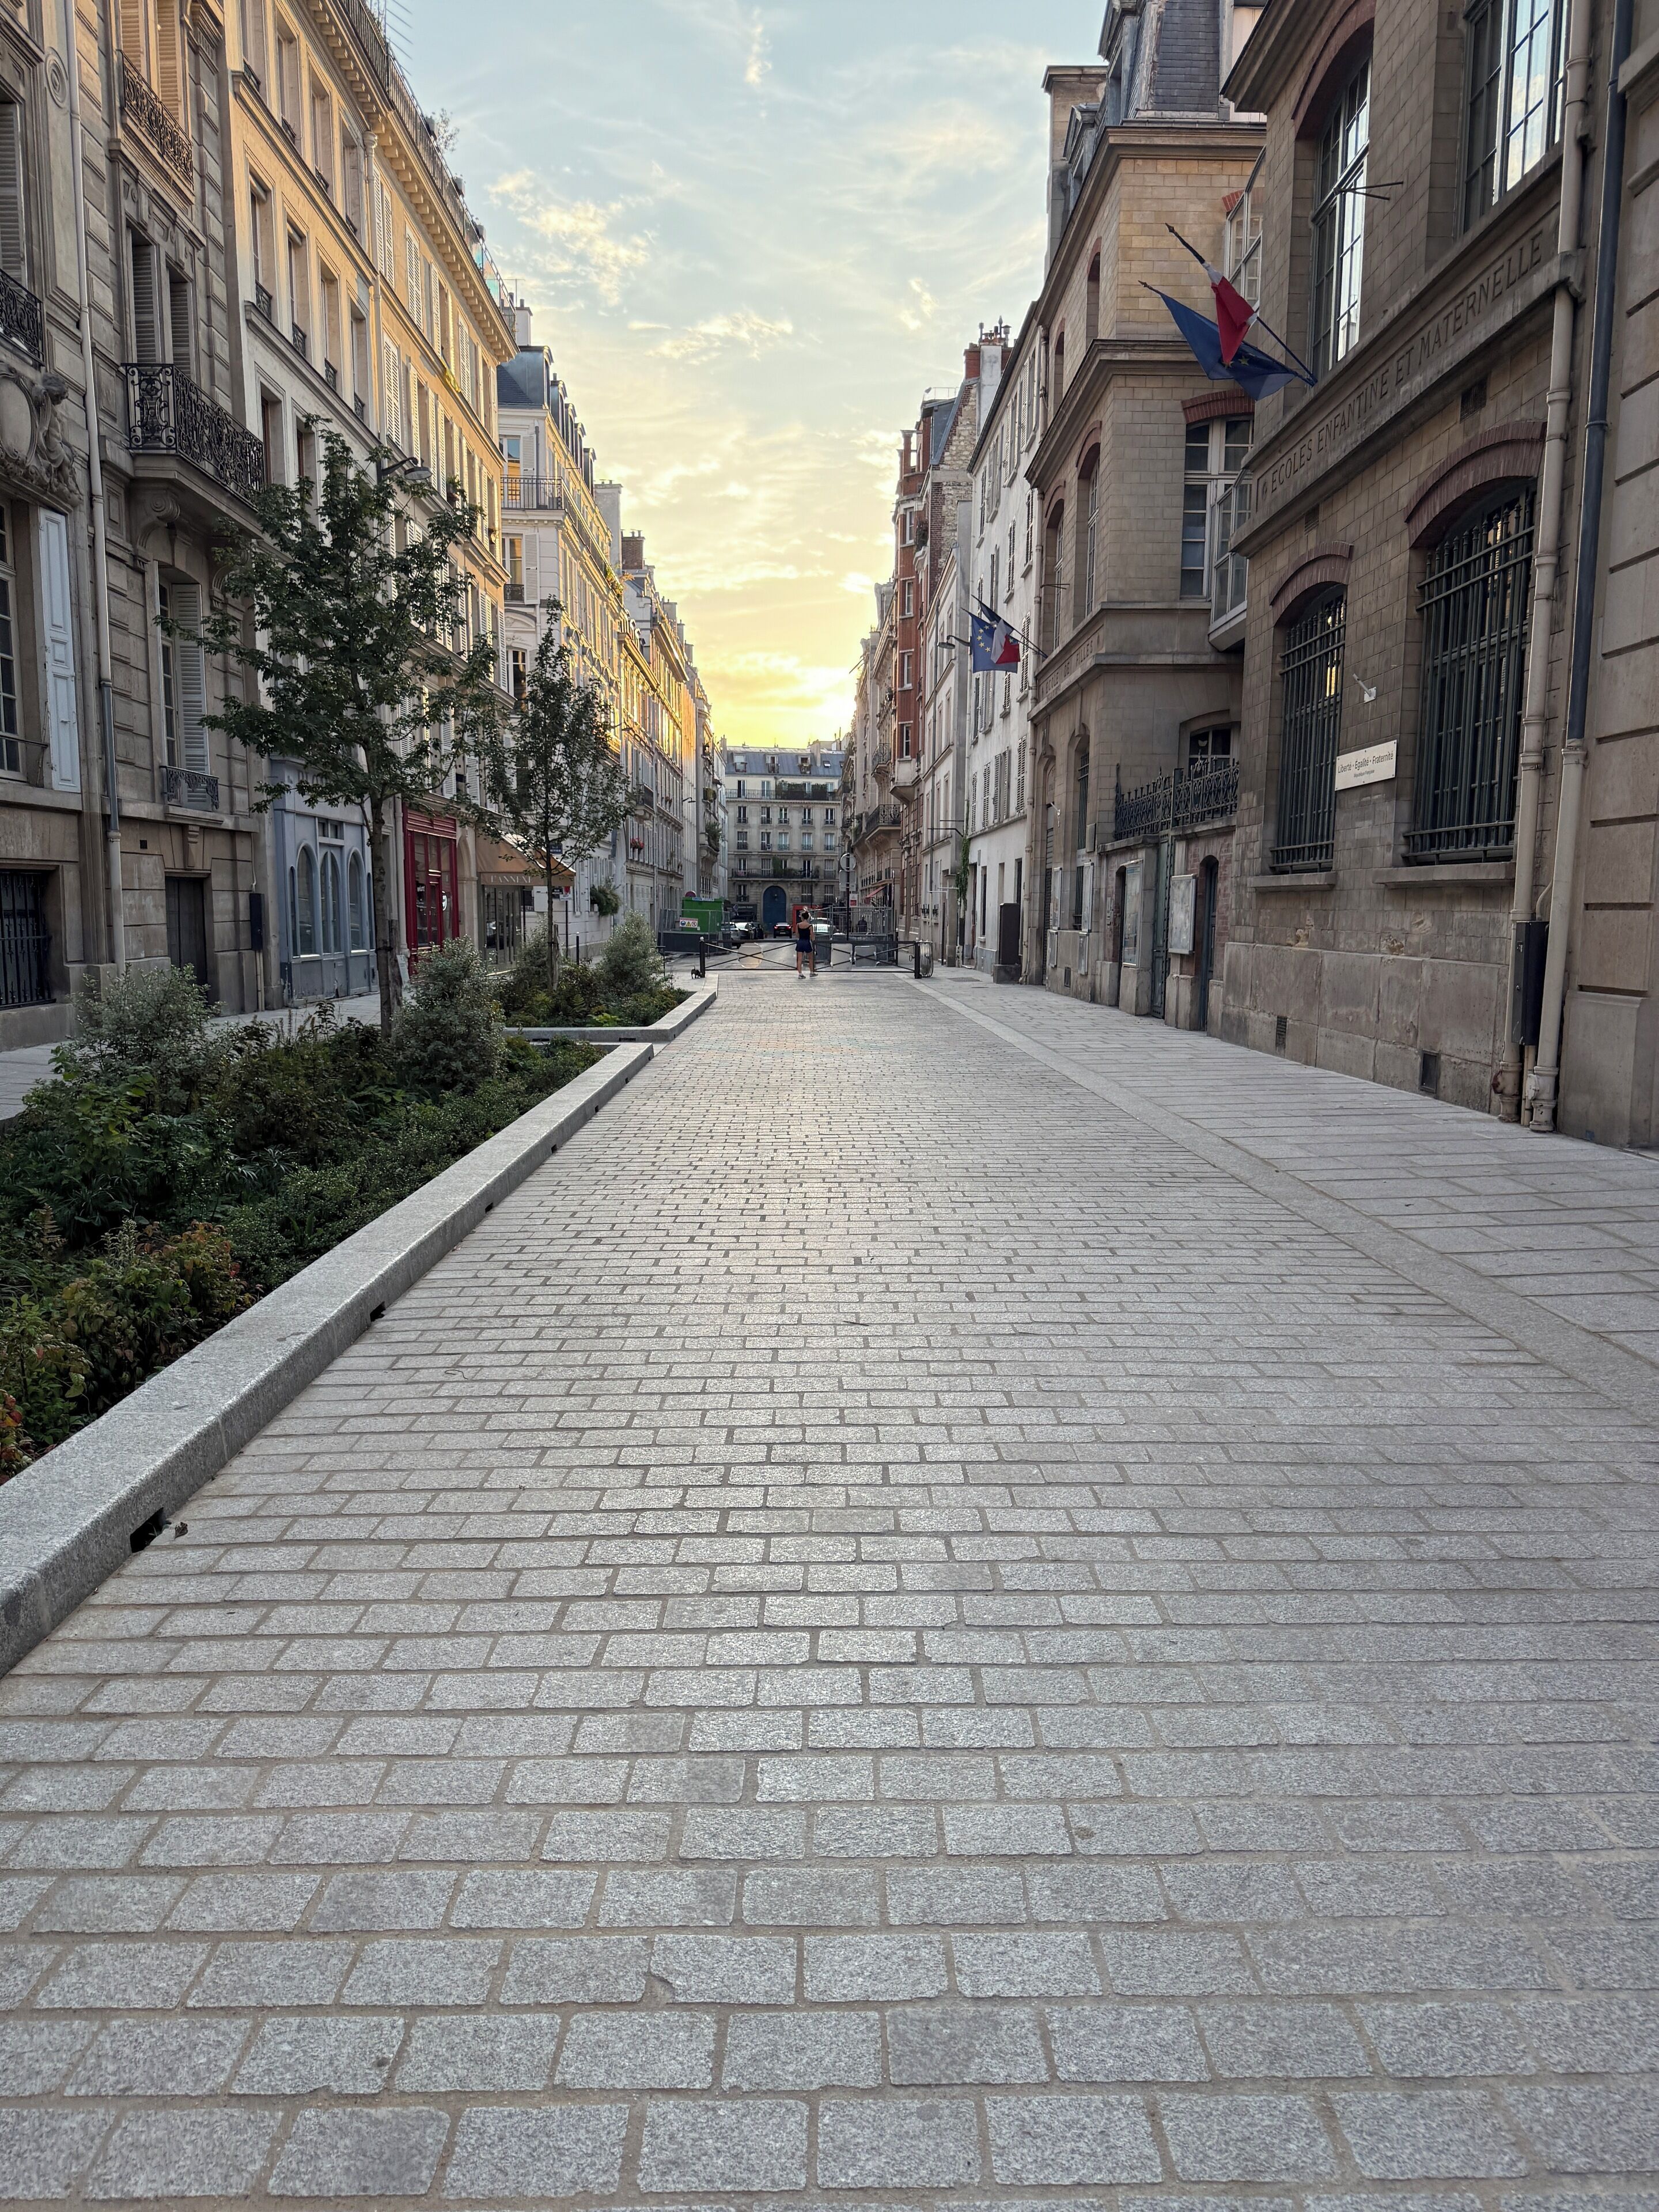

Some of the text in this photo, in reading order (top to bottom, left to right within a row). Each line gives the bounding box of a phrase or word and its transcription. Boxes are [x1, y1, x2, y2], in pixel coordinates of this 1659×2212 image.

[1271, 230, 1543, 494] ECOLES ENFANTINE ET MATERNELLE
[1046, 672, 1059, 694] ECOLE
[1075, 640, 1093, 665] FILLES
[1338, 751, 1393, 774] Liberté Égalité Fraternité
